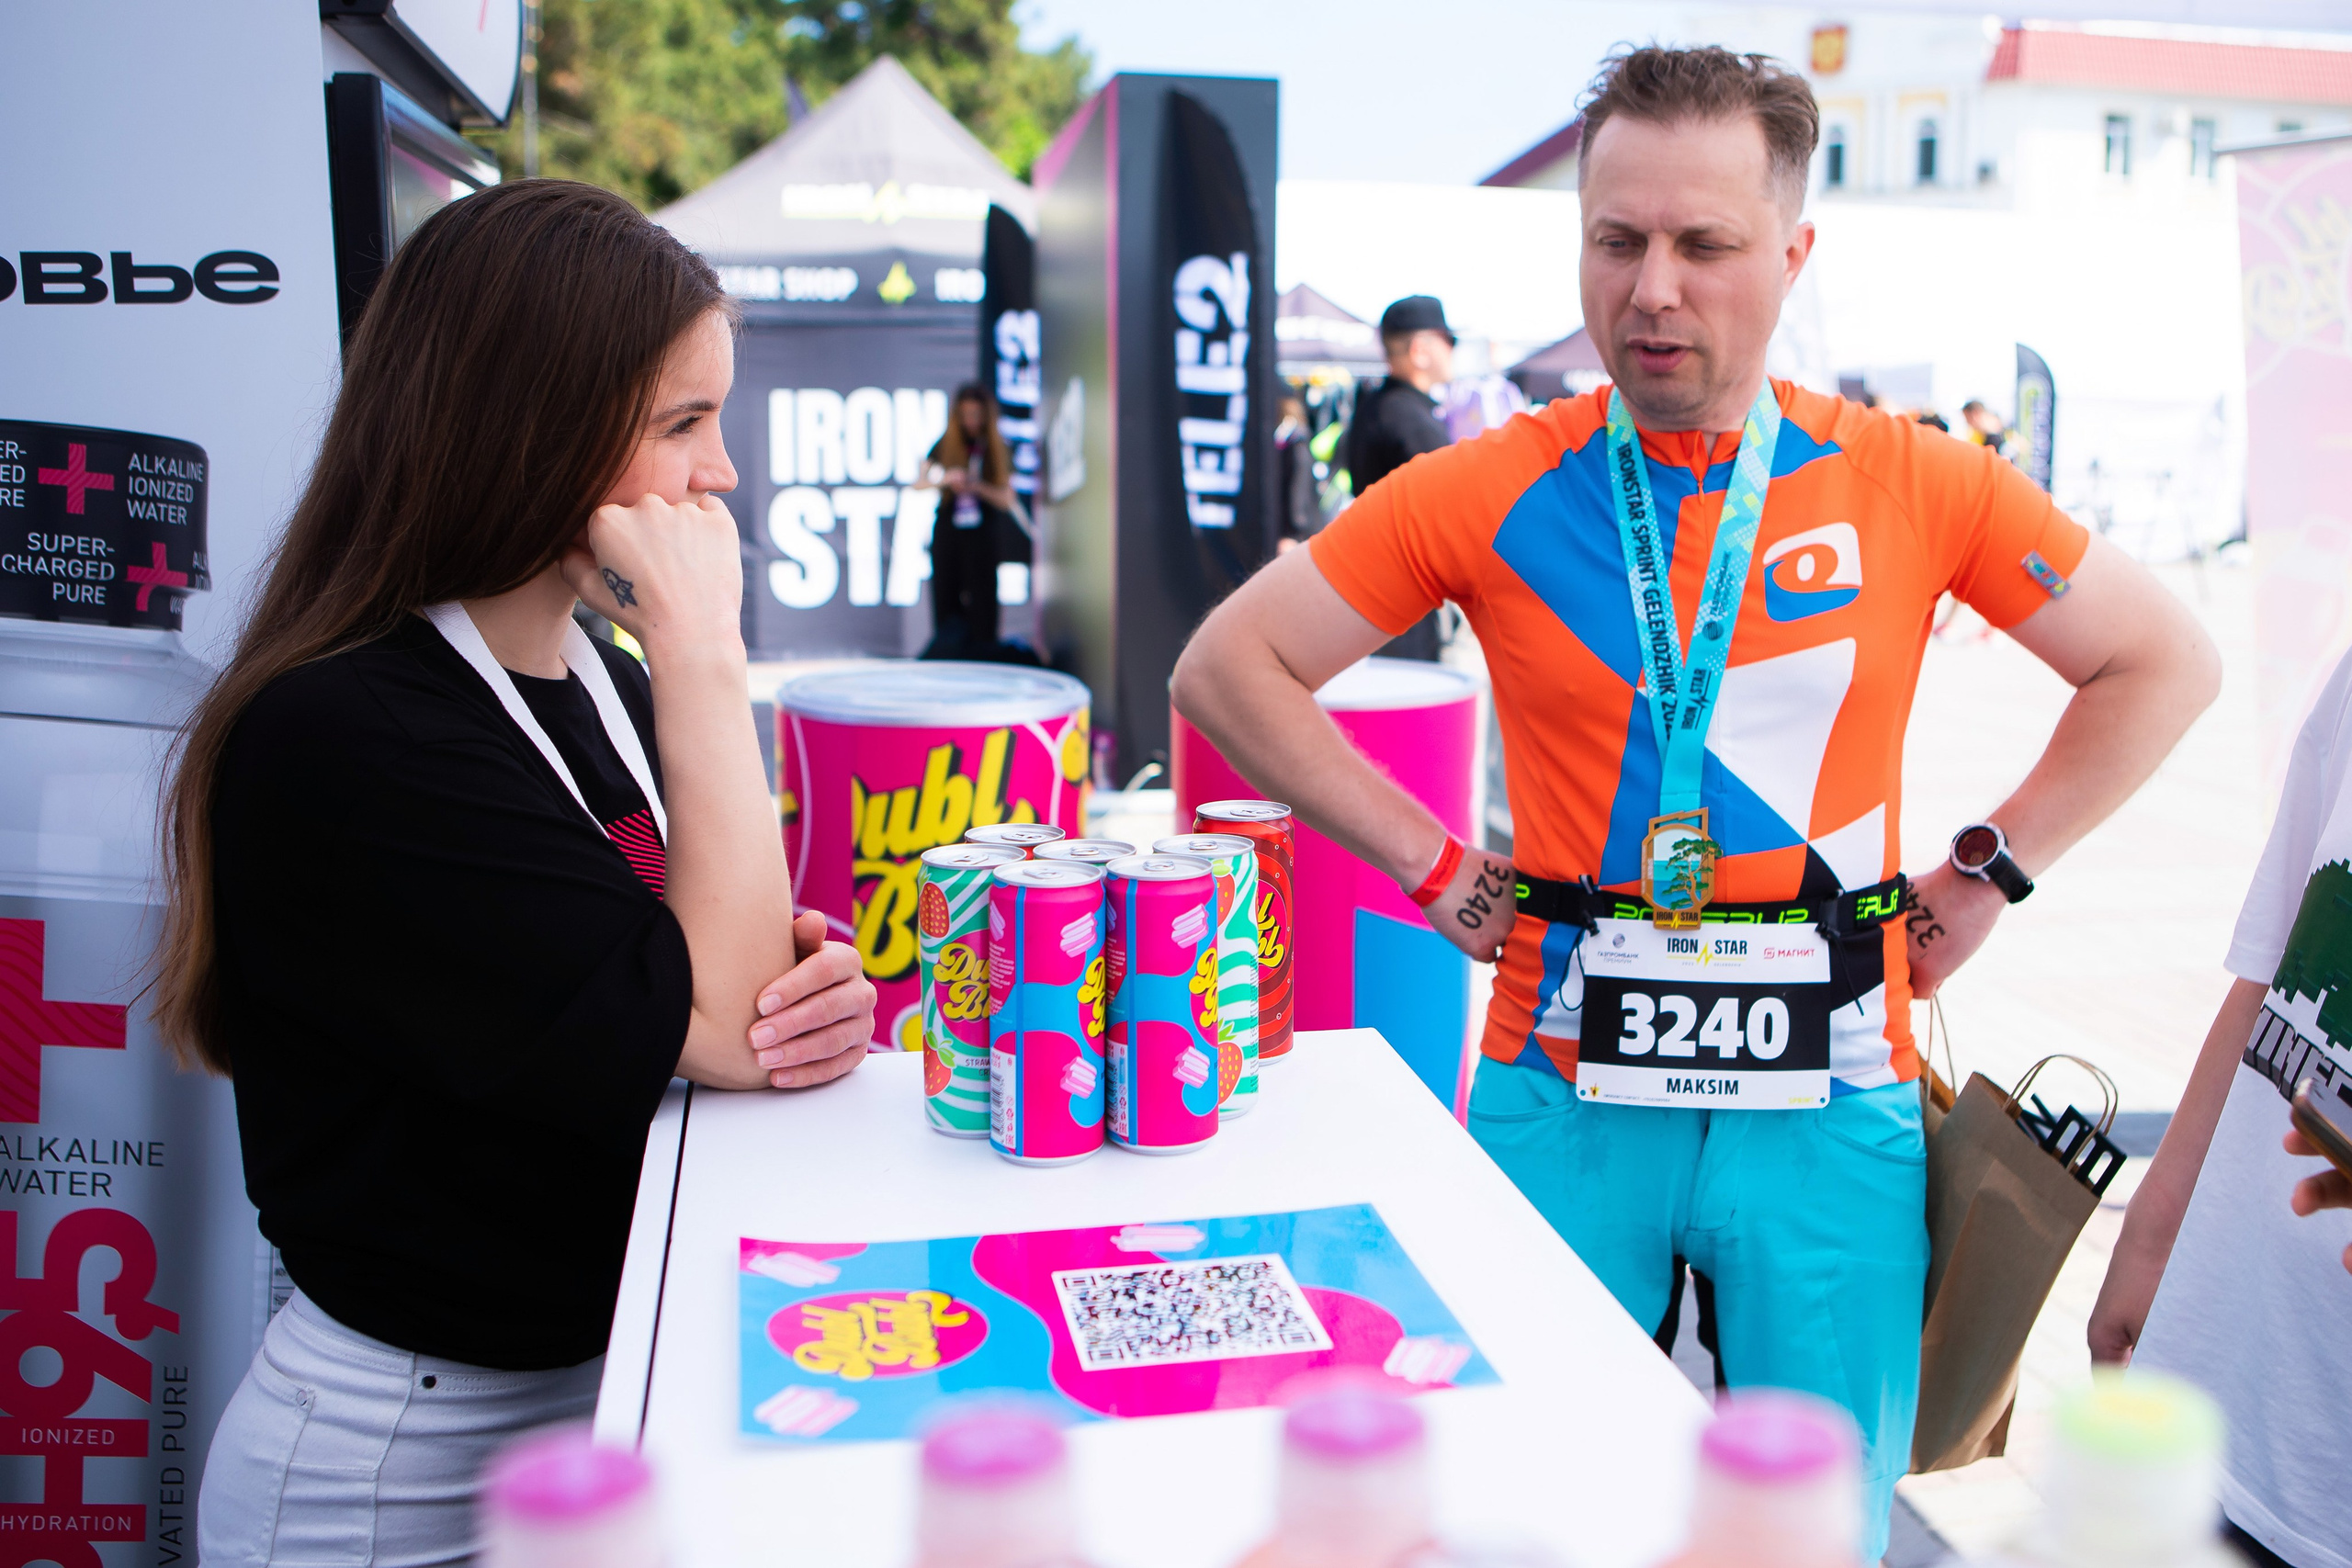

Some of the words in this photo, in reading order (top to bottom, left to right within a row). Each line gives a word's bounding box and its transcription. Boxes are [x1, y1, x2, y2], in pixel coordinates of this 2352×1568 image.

[0, 250, 280, 305] вье
[768, 387, 948, 486] IRON
[128, 452, 204, 482] ALKALINE
[1617, 442, 1646, 521] IRONSTAR
[129, 475, 194, 503] IONIZED
[127, 499, 187, 525] WATER
[28, 532, 116, 557] SUPER-
[767, 486, 1030, 608] STA
[1632, 525, 1658, 583] SPRINT
[1, 554, 116, 581] CHARGED
[52, 582, 107, 605] PURE
[1643, 589, 1678, 695] GELENDZHIK
[1681, 705, 1699, 729] IRON
[1690, 668, 1707, 697] STAR
[1456, 859, 1510, 930] 3240
[1657, 911, 1674, 920] IRON
[1680, 911, 1699, 921] STAR
[1668, 938, 1699, 953] IRON
[1714, 939, 1747, 954] STAR
[1778, 948, 1815, 957] МАГНИТ
[1619, 993, 1790, 1060] 3240
[1667, 1078, 1739, 1095] MAKSIM
[0, 1135, 165, 1167] ALKALINE
[162, 1366, 189, 1452] PURE
[22, 1428, 115, 1445] IONIZED
[1, 1515, 131, 1531] HYDRATION
